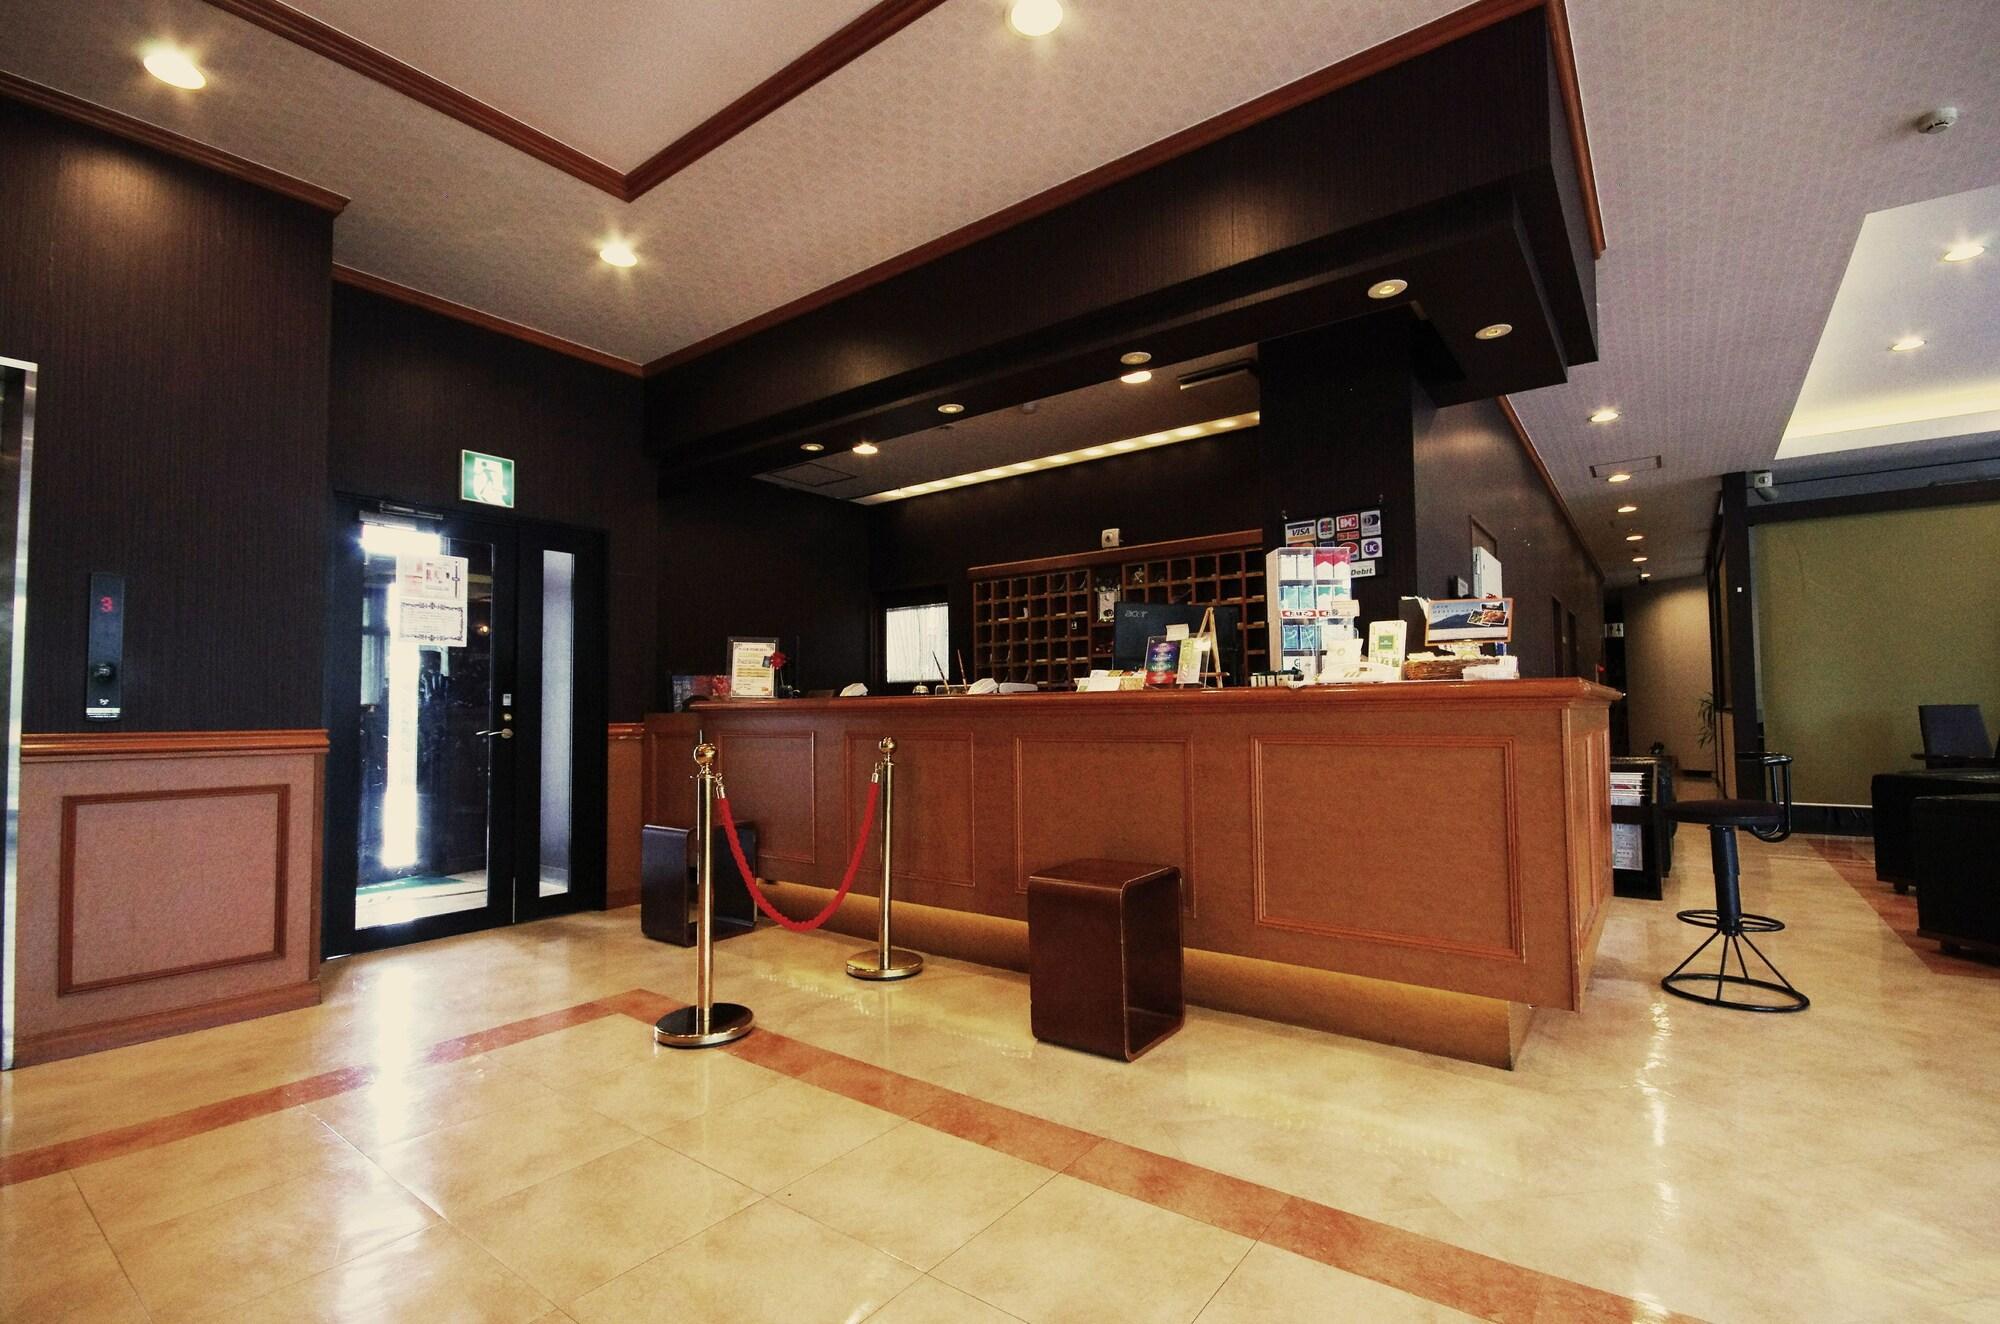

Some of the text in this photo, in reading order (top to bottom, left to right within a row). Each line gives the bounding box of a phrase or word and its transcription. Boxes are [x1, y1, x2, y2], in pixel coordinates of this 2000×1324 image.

[1292, 527, 1310, 537] VISA
[1365, 544, 1378, 553] UC
[101, 596, 113, 613] 3
